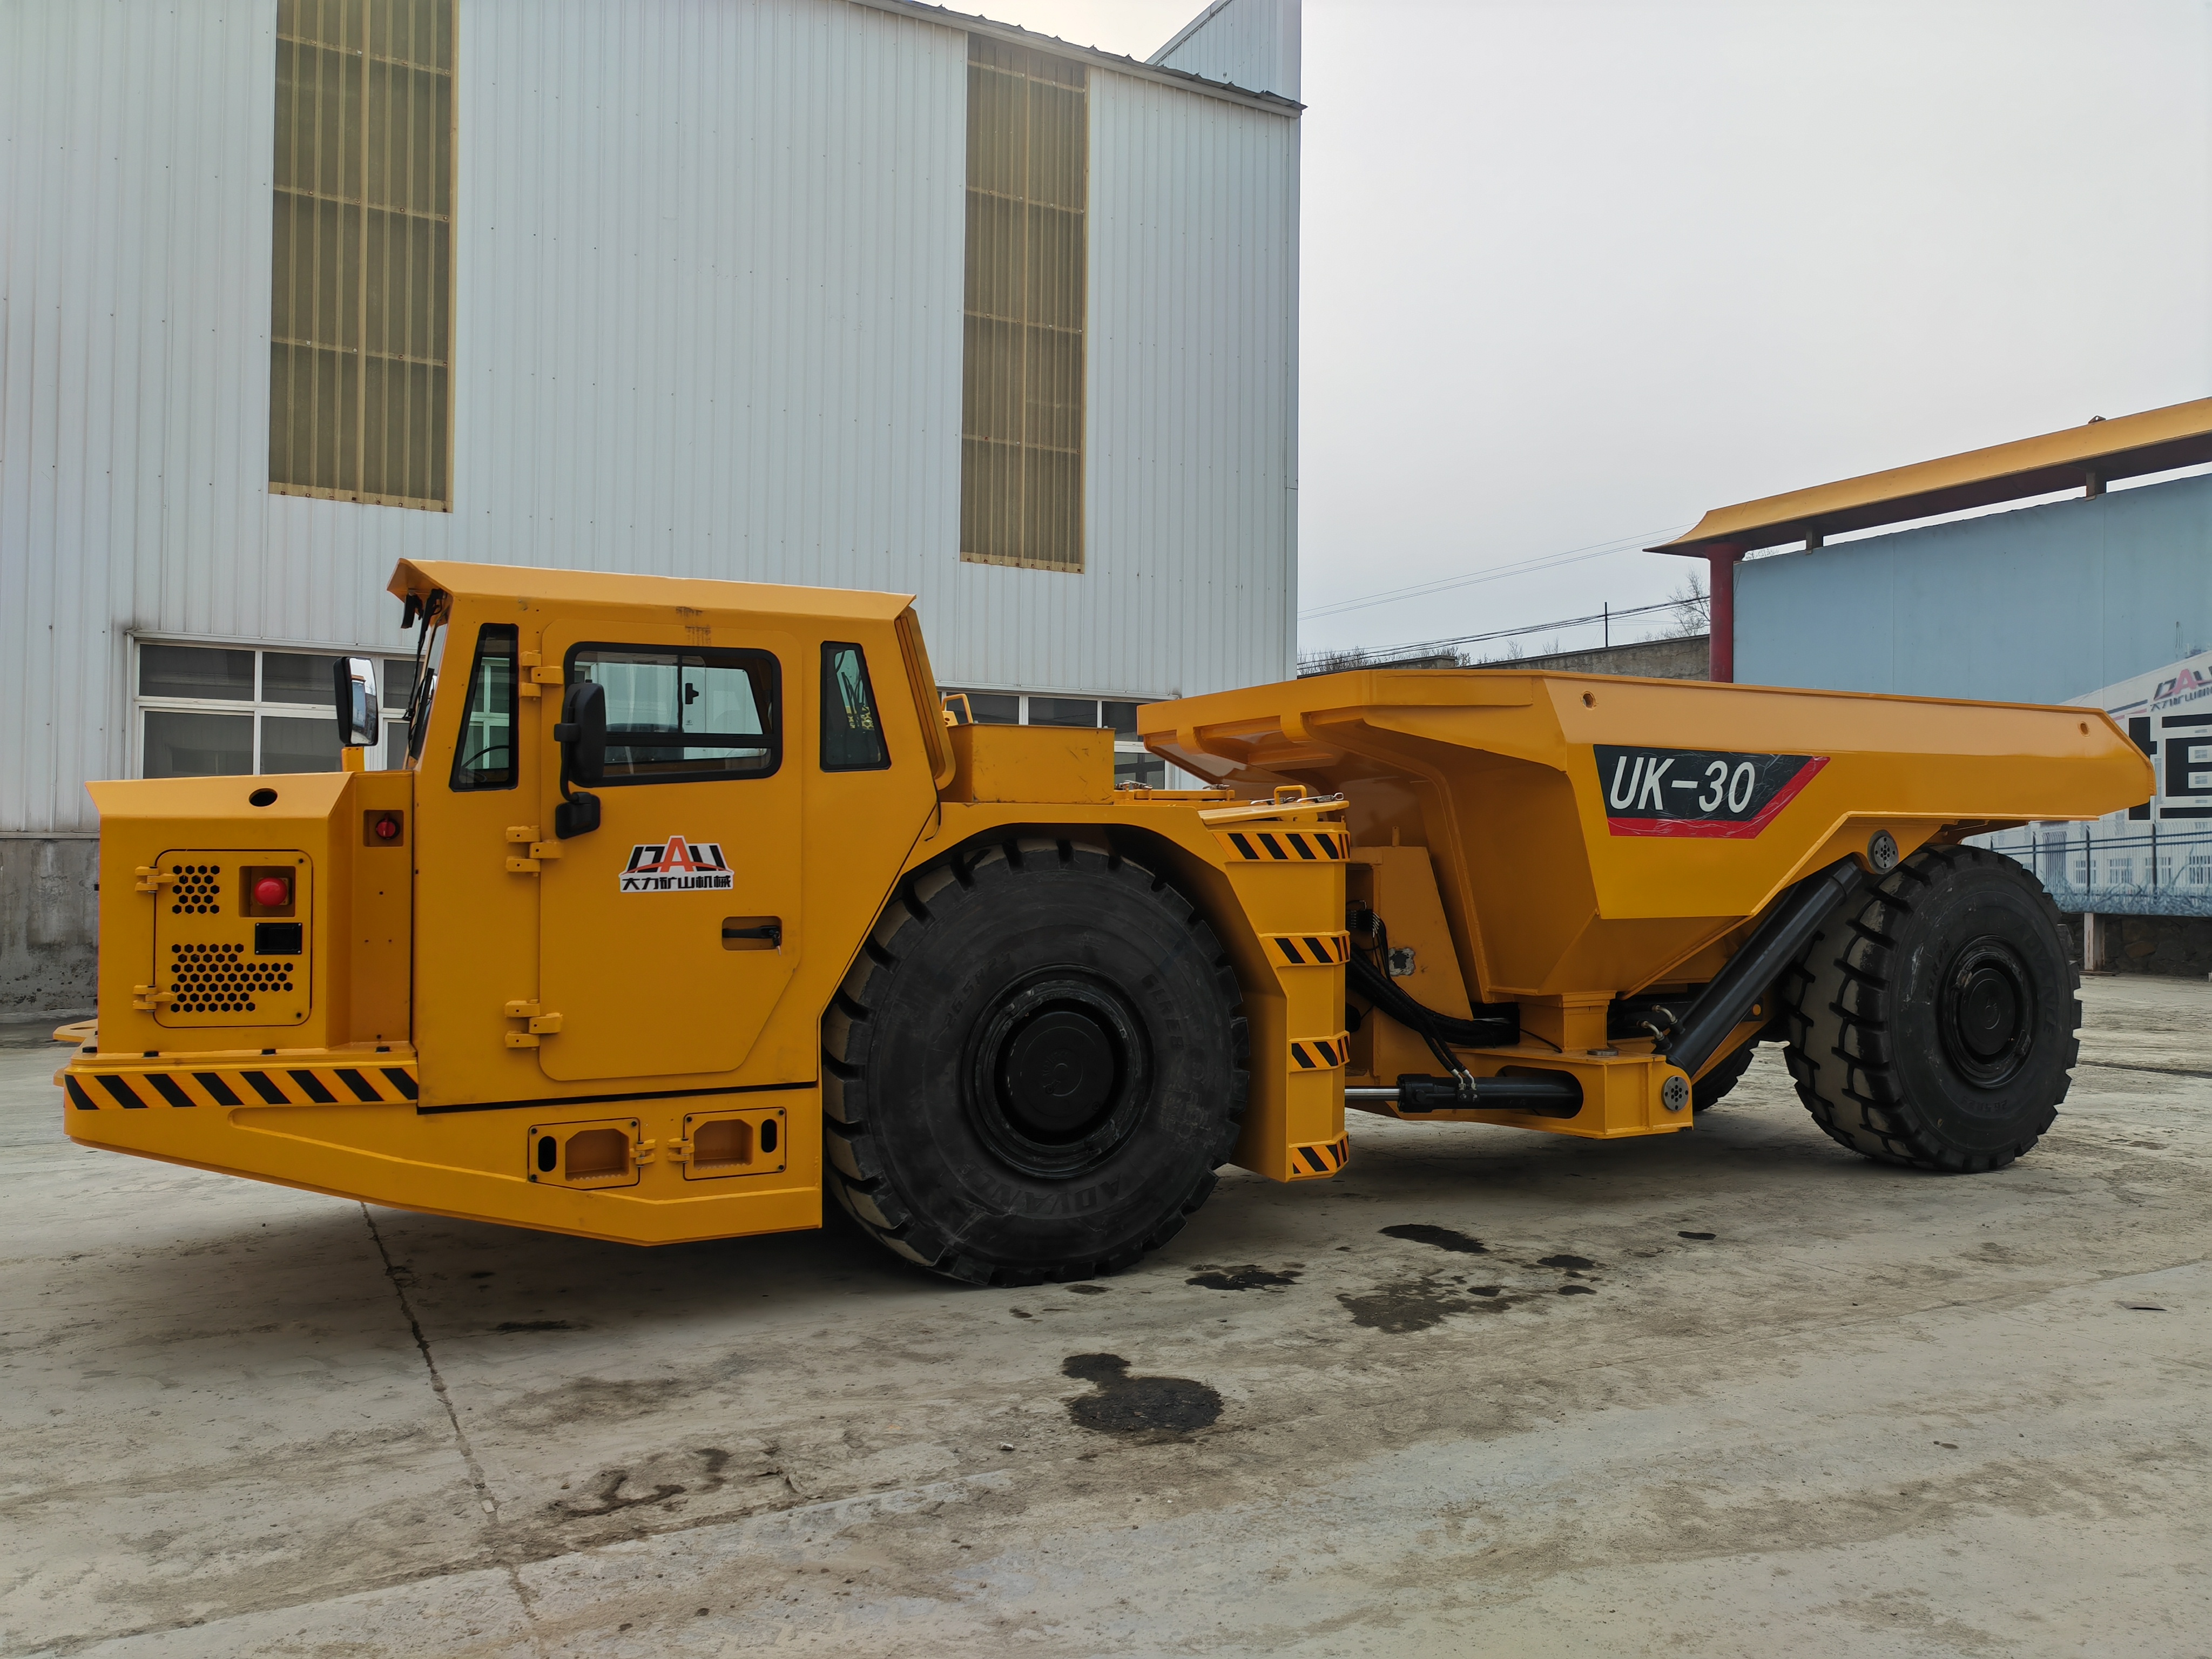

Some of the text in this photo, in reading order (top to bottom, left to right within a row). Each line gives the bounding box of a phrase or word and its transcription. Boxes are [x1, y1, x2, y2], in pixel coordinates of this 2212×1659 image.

[1610, 756, 1756, 813] UK-30
[622, 875, 731, 891] 大力矿山机械
